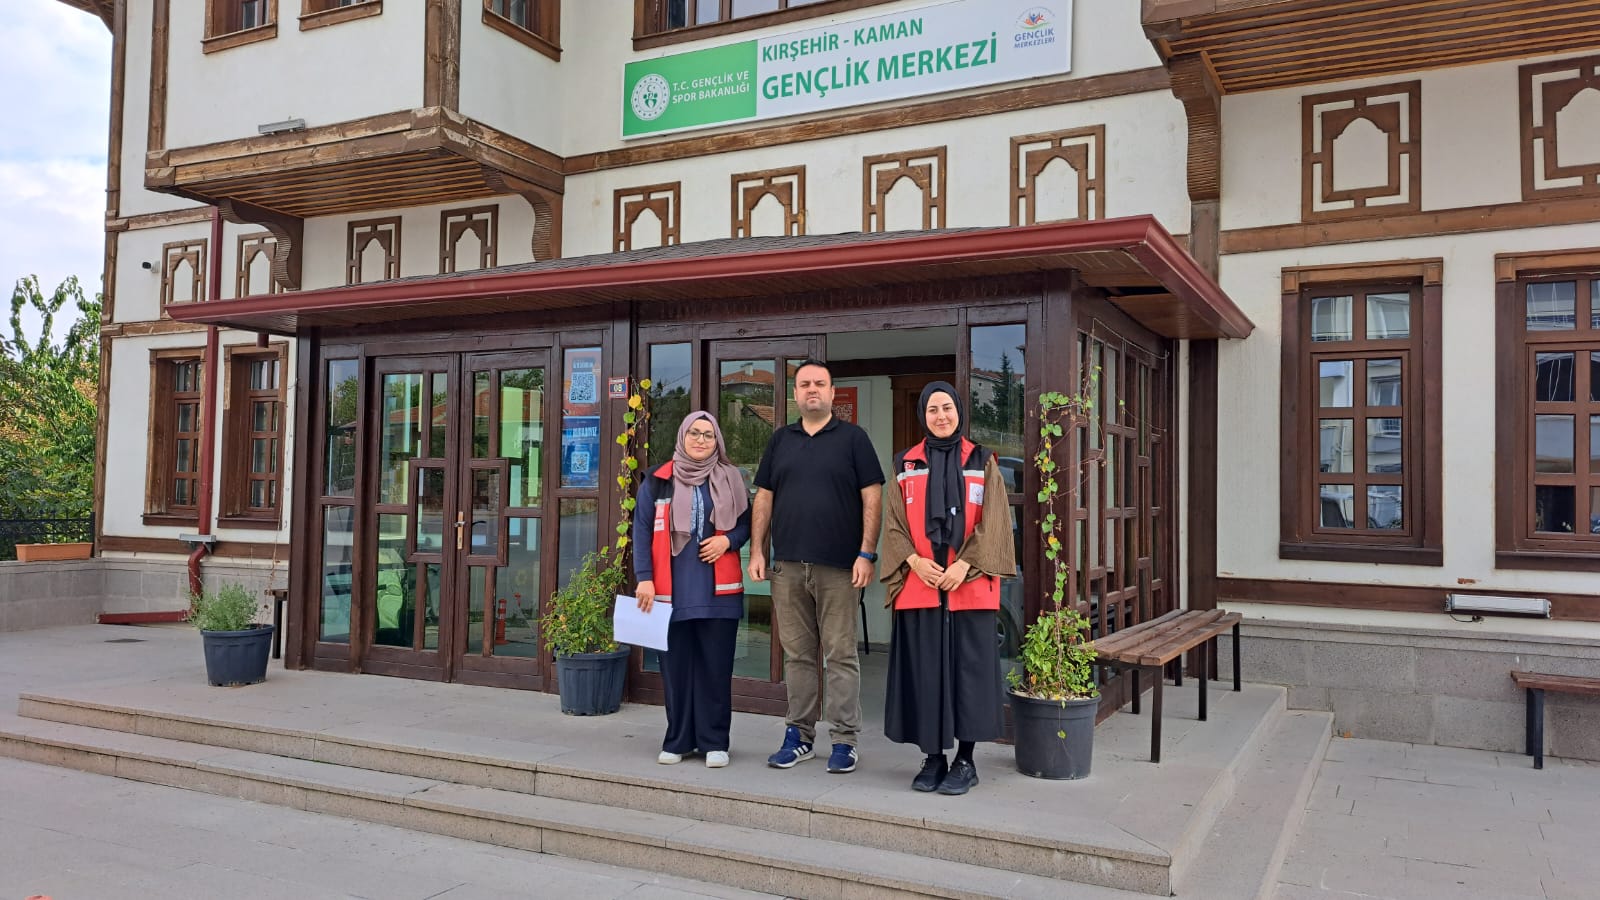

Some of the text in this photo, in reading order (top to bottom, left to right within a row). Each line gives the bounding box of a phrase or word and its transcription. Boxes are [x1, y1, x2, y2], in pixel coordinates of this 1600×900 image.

[762, 31, 840, 62] KIRŞEHİR
[854, 17, 924, 47] KAMAN
[672, 70, 750, 92] T.C. GENÇLİK VE
[762, 31, 998, 100] GENÇLİK MERKEZİ
[672, 83, 750, 104] SPOR BAKANLIĞI
